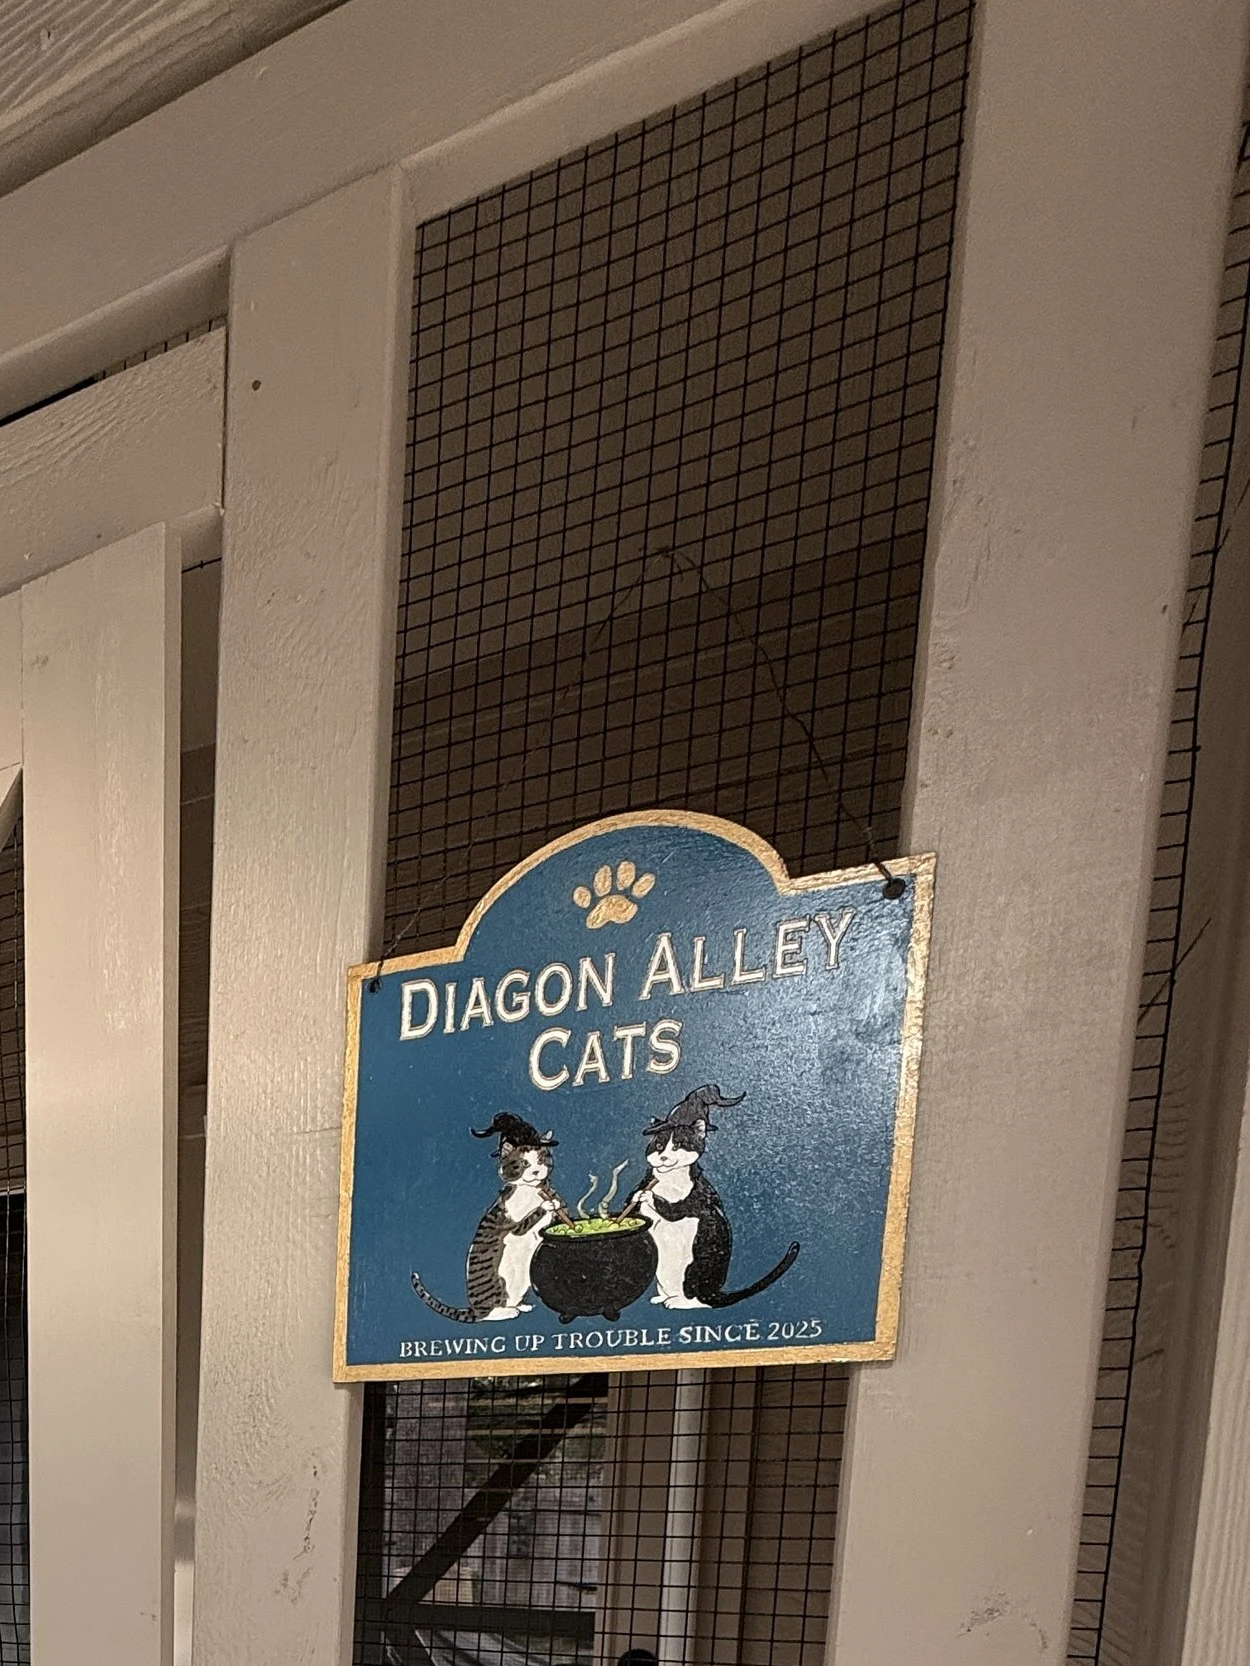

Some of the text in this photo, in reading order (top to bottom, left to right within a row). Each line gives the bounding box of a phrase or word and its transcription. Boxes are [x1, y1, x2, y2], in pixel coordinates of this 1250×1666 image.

[399, 909, 858, 1041] DIAGON ALLEY
[528, 1019, 684, 1091] CATS
[399, 1319, 823, 1358] BREWING UP TROUBLE SINCE 2025
